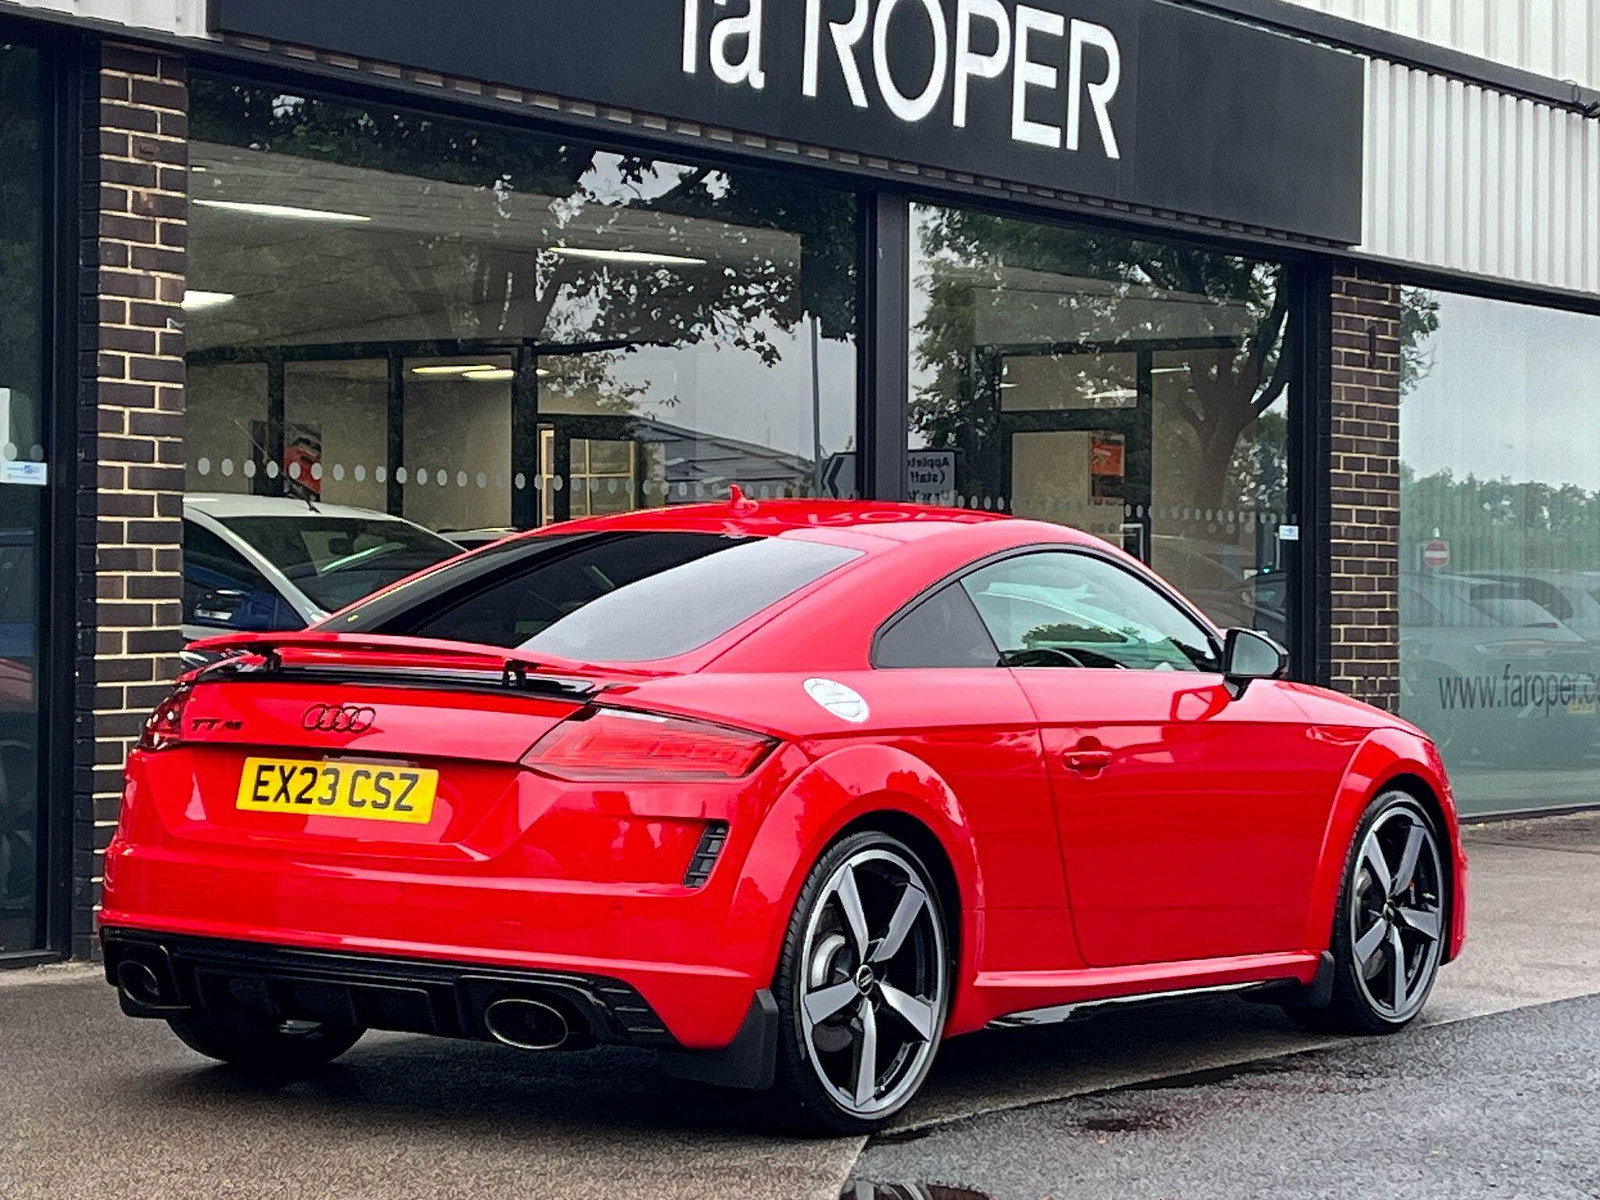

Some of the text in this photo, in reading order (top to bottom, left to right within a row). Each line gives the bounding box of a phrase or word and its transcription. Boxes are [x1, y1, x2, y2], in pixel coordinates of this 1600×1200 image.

[803, 0, 1120, 159] ROPER
[251, 764, 419, 811] EX23 CSZ
